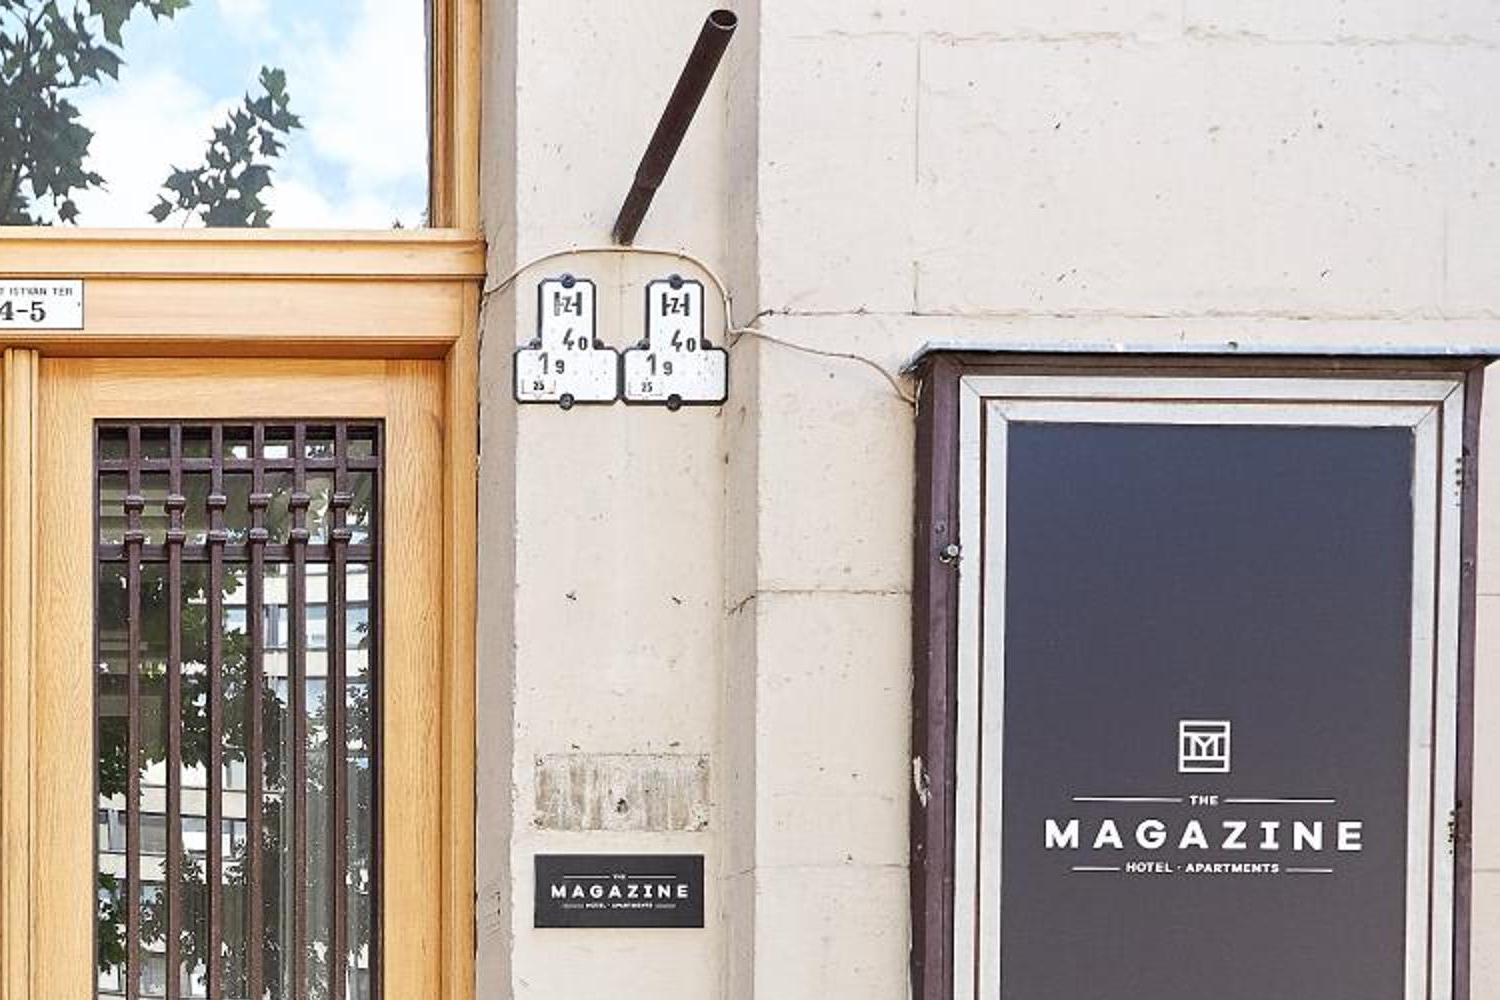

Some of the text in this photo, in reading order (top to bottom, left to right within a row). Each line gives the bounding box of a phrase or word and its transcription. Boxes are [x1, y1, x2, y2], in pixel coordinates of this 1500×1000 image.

[1189, 795, 1219, 806] THE
[1045, 819, 1363, 851] MAGAZINE
[1125, 861, 1279, 873] HOTEL APARTMENTS
[551, 884, 689, 899] MAGAZINE
